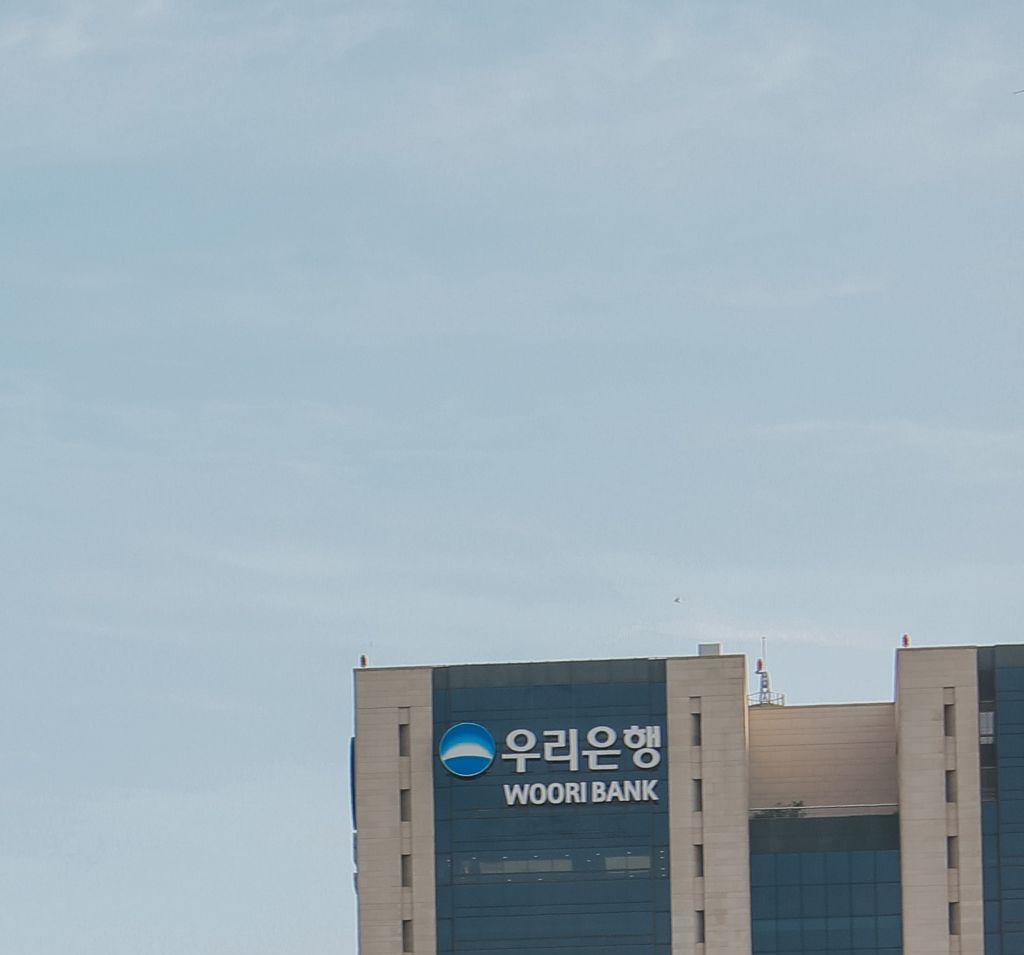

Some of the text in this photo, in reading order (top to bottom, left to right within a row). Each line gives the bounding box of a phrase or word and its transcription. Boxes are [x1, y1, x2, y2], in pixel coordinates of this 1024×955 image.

[501, 725, 662, 773] 우리은행
[503, 779, 660, 805] WOORI BANK
